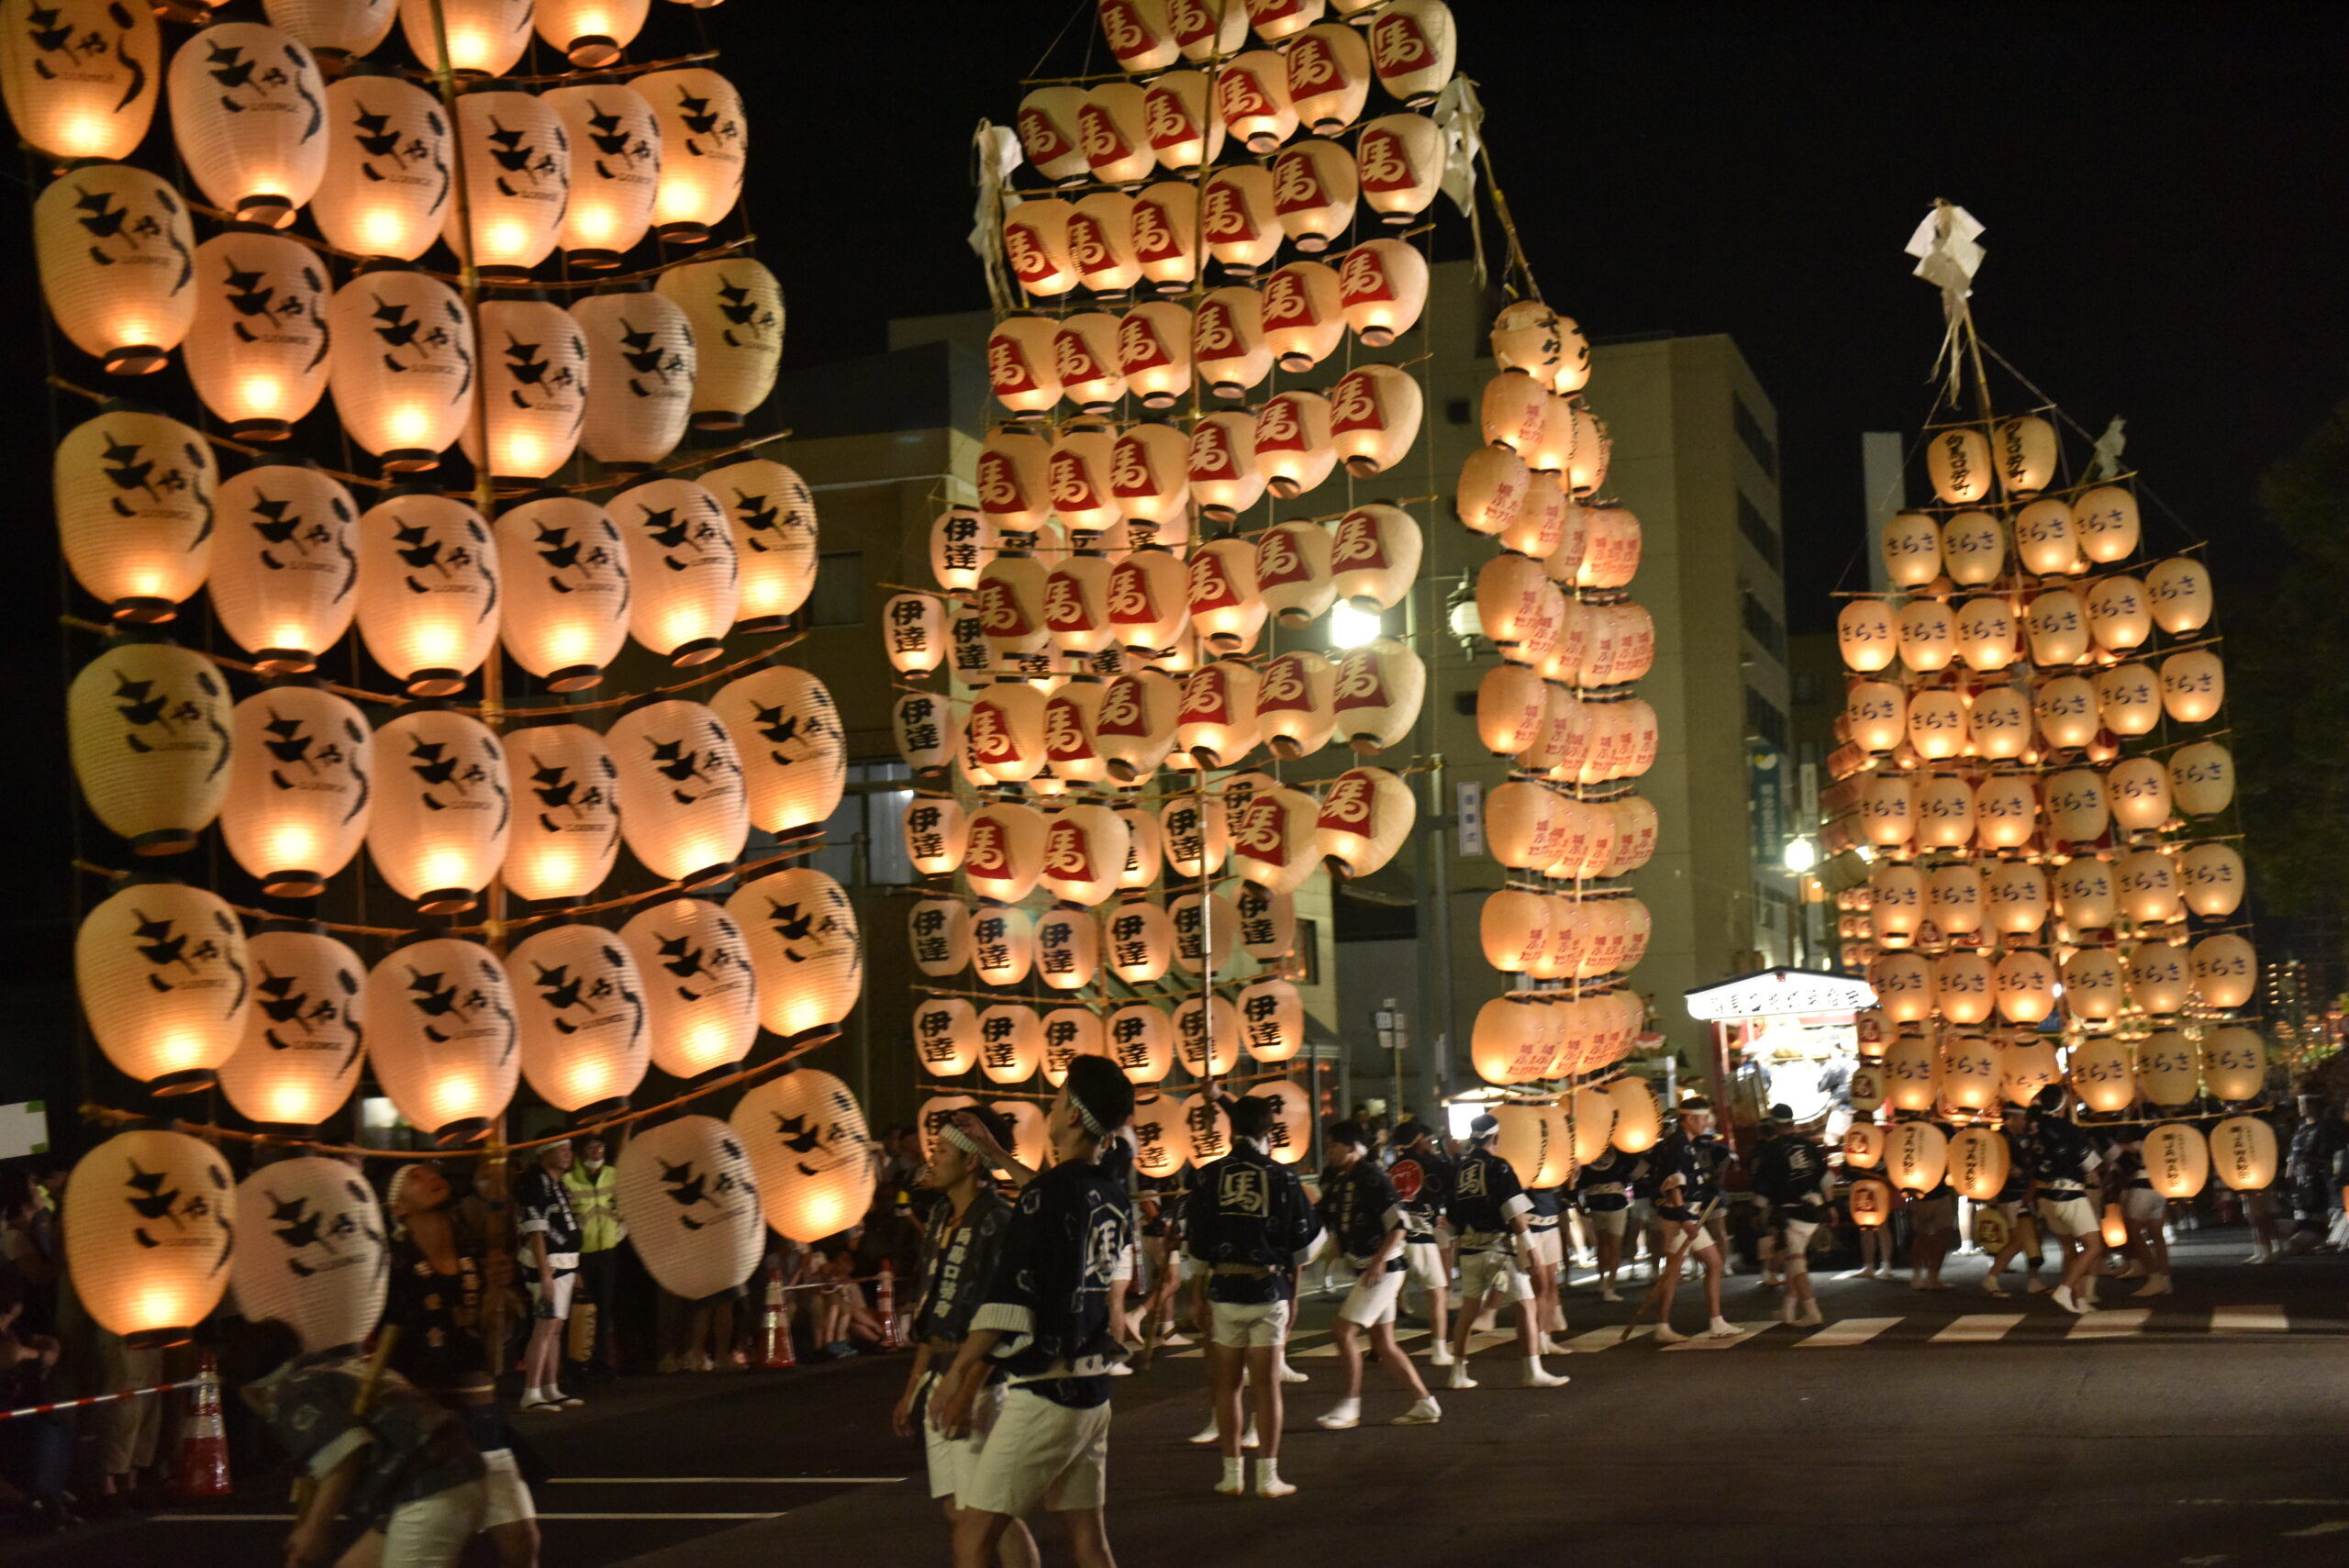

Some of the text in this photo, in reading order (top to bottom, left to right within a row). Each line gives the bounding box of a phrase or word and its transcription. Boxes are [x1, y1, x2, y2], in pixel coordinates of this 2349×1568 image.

[1102, 6, 1141, 50] 馬
[1378, 18, 1423, 66] 馬
[1289, 38, 1333, 87] 馬
[1220, 74, 1263, 114] 馬
[1020, 115, 1056, 155] 馬
[1079, 114, 1117, 156] 馬
[1146, 97, 1186, 139] 馬
[1274, 156, 1316, 202] 馬
[1361, 139, 1404, 183] 馬
[1133, 208, 1169, 253] 馬
[1204, 189, 1244, 236] 馬
[1008, 231, 1045, 274] 馬
[1341, 250, 1382, 296] 馬
[1263, 276, 1305, 323] 馬
[1119, 322, 1154, 363] 馬
[1196, 306, 1232, 350] 馬
[990, 343, 1025, 385] 馬
[1055, 332, 1090, 374] 馬
[1256, 400, 1297, 442] 馬
[1332, 377, 1374, 423] 馬
[1111, 440, 1148, 488] 馬
[1189, 424, 1227, 472] 馬
[978, 460, 1016, 505] 馬
[1051, 456, 1086, 501] 馬
[944, 517, 979, 571] 伊達
[1257, 532, 1297, 575] 馬
[1333, 517, 1377, 564] 馬
[1046, 576, 1081, 623] 馬
[1108, 569, 1145, 614] 馬
[1189, 556, 1225, 602] 馬
[893, 600, 925, 653] 伊達
[981, 584, 1017, 628] 馬
[953, 617, 989, 671] 伊達
[1180, 669, 1221, 716] 馬
[1258, 657, 1302, 701] 馬
[1335, 653, 1378, 699] 馬
[901, 698, 940, 752] 伊達
[1100, 680, 1140, 727] 馬
[973, 708, 1009, 756] 馬
[1046, 706, 1082, 751] 馬
[1321, 777, 1368, 823] 馬
[909, 806, 944, 858] 伊達
[967, 824, 1005, 870] 馬
[1046, 824, 1085, 872] 馬
[1167, 807, 1200, 862] 伊達
[1236, 804, 1279, 851] 馬
[914, 909, 950, 962] 伊達
[974, 917, 1010, 971] 伊達
[1041, 923, 1074, 974] 伊達
[1112, 915, 1147, 967] 伊達
[920, 1010, 954, 1062] 伊達
[982, 1017, 1015, 1068] 伊達
[1112, 1018, 1148, 1068] 伊達
[1245, 995, 1282, 1047] 伊達
[1137, 1122, 1169, 1169] 伊達
[1219, 1171, 1262, 1211] 馬
